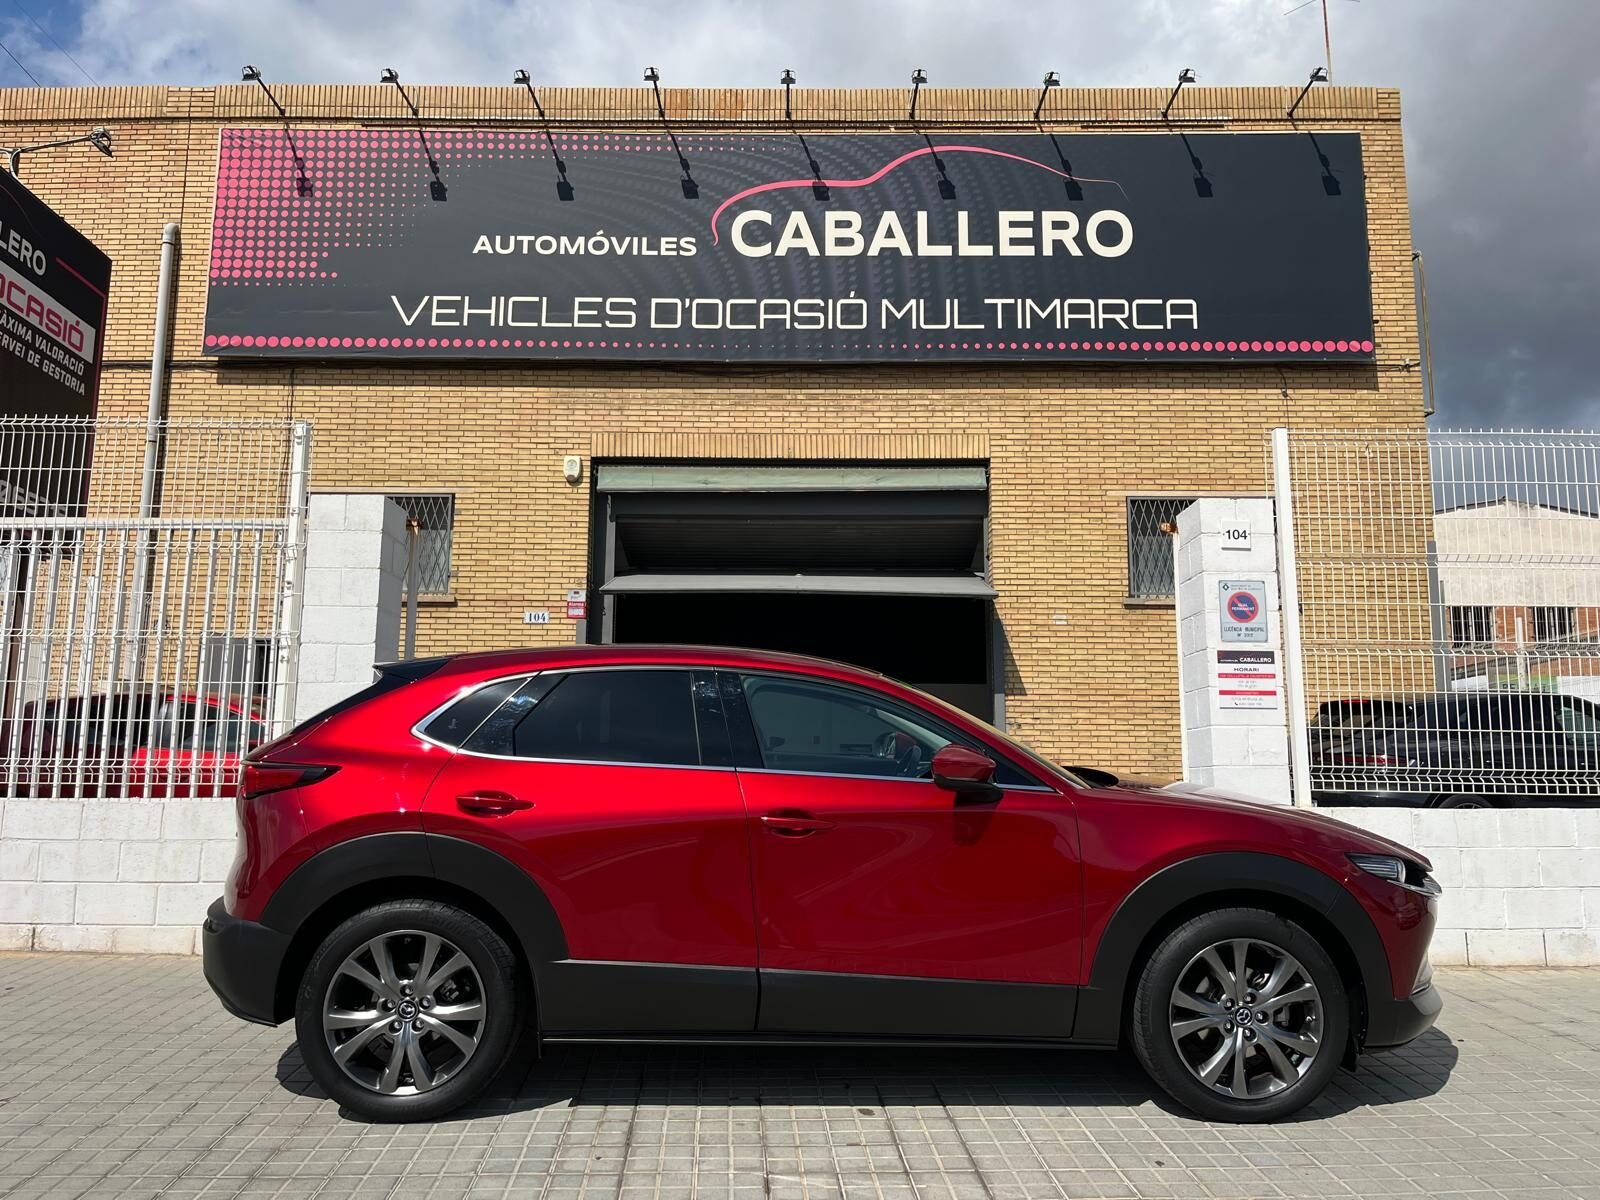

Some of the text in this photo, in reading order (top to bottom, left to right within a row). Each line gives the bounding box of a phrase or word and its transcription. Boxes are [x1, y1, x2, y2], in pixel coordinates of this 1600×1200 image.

[472, 209, 1134, 258] AUTOMÓVILES CABALLERO
[391, 290, 1199, 330] VEHICLES D'OCASIÓ MULTIMARCA
[27, 349, 41, 368] DE
[42, 359, 85, 396] GESTORIA
[35, 334, 84, 376] VALORACIÓ
[1225, 529, 1248, 540] 104
[529, 612, 546, 622] 104
